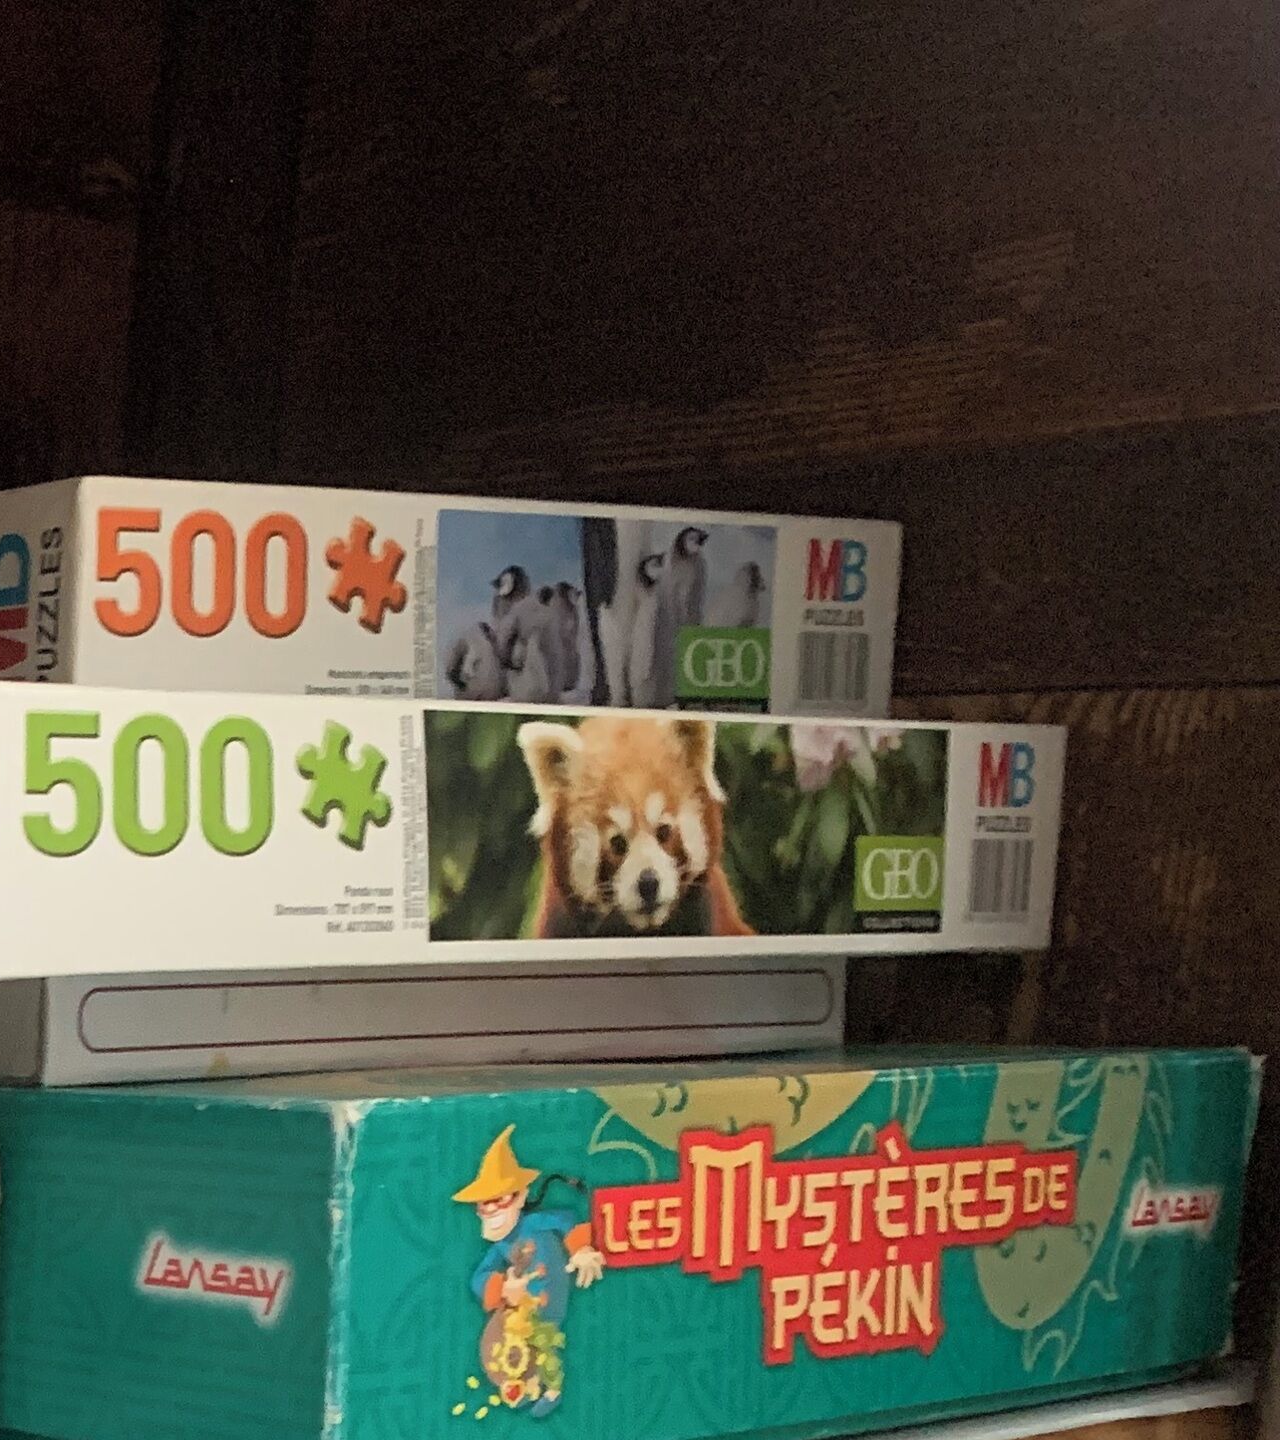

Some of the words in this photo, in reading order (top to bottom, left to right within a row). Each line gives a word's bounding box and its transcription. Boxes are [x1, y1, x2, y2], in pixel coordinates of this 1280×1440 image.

[93, 506, 310, 640] 500
[804, 537, 869, 603] MB
[36, 525, 63, 683] UZZLES
[802, 607, 866, 628] PUZZLES
[683, 637, 767, 689] GEO
[977, 741, 1036, 808] MB
[975, 815, 1033, 834] PUZZLES
[862, 847, 939, 902] GEO
[602, 1197, 682, 1254] LES
[689, 1136, 1017, 1268] MYSTÈRES
[1022, 1164, 1070, 1214] DE
[1132, 1182, 1220, 1233] Lansay
[144, 1238, 279, 1316] Lansay
[771, 1243, 934, 1350] PÉKIN
